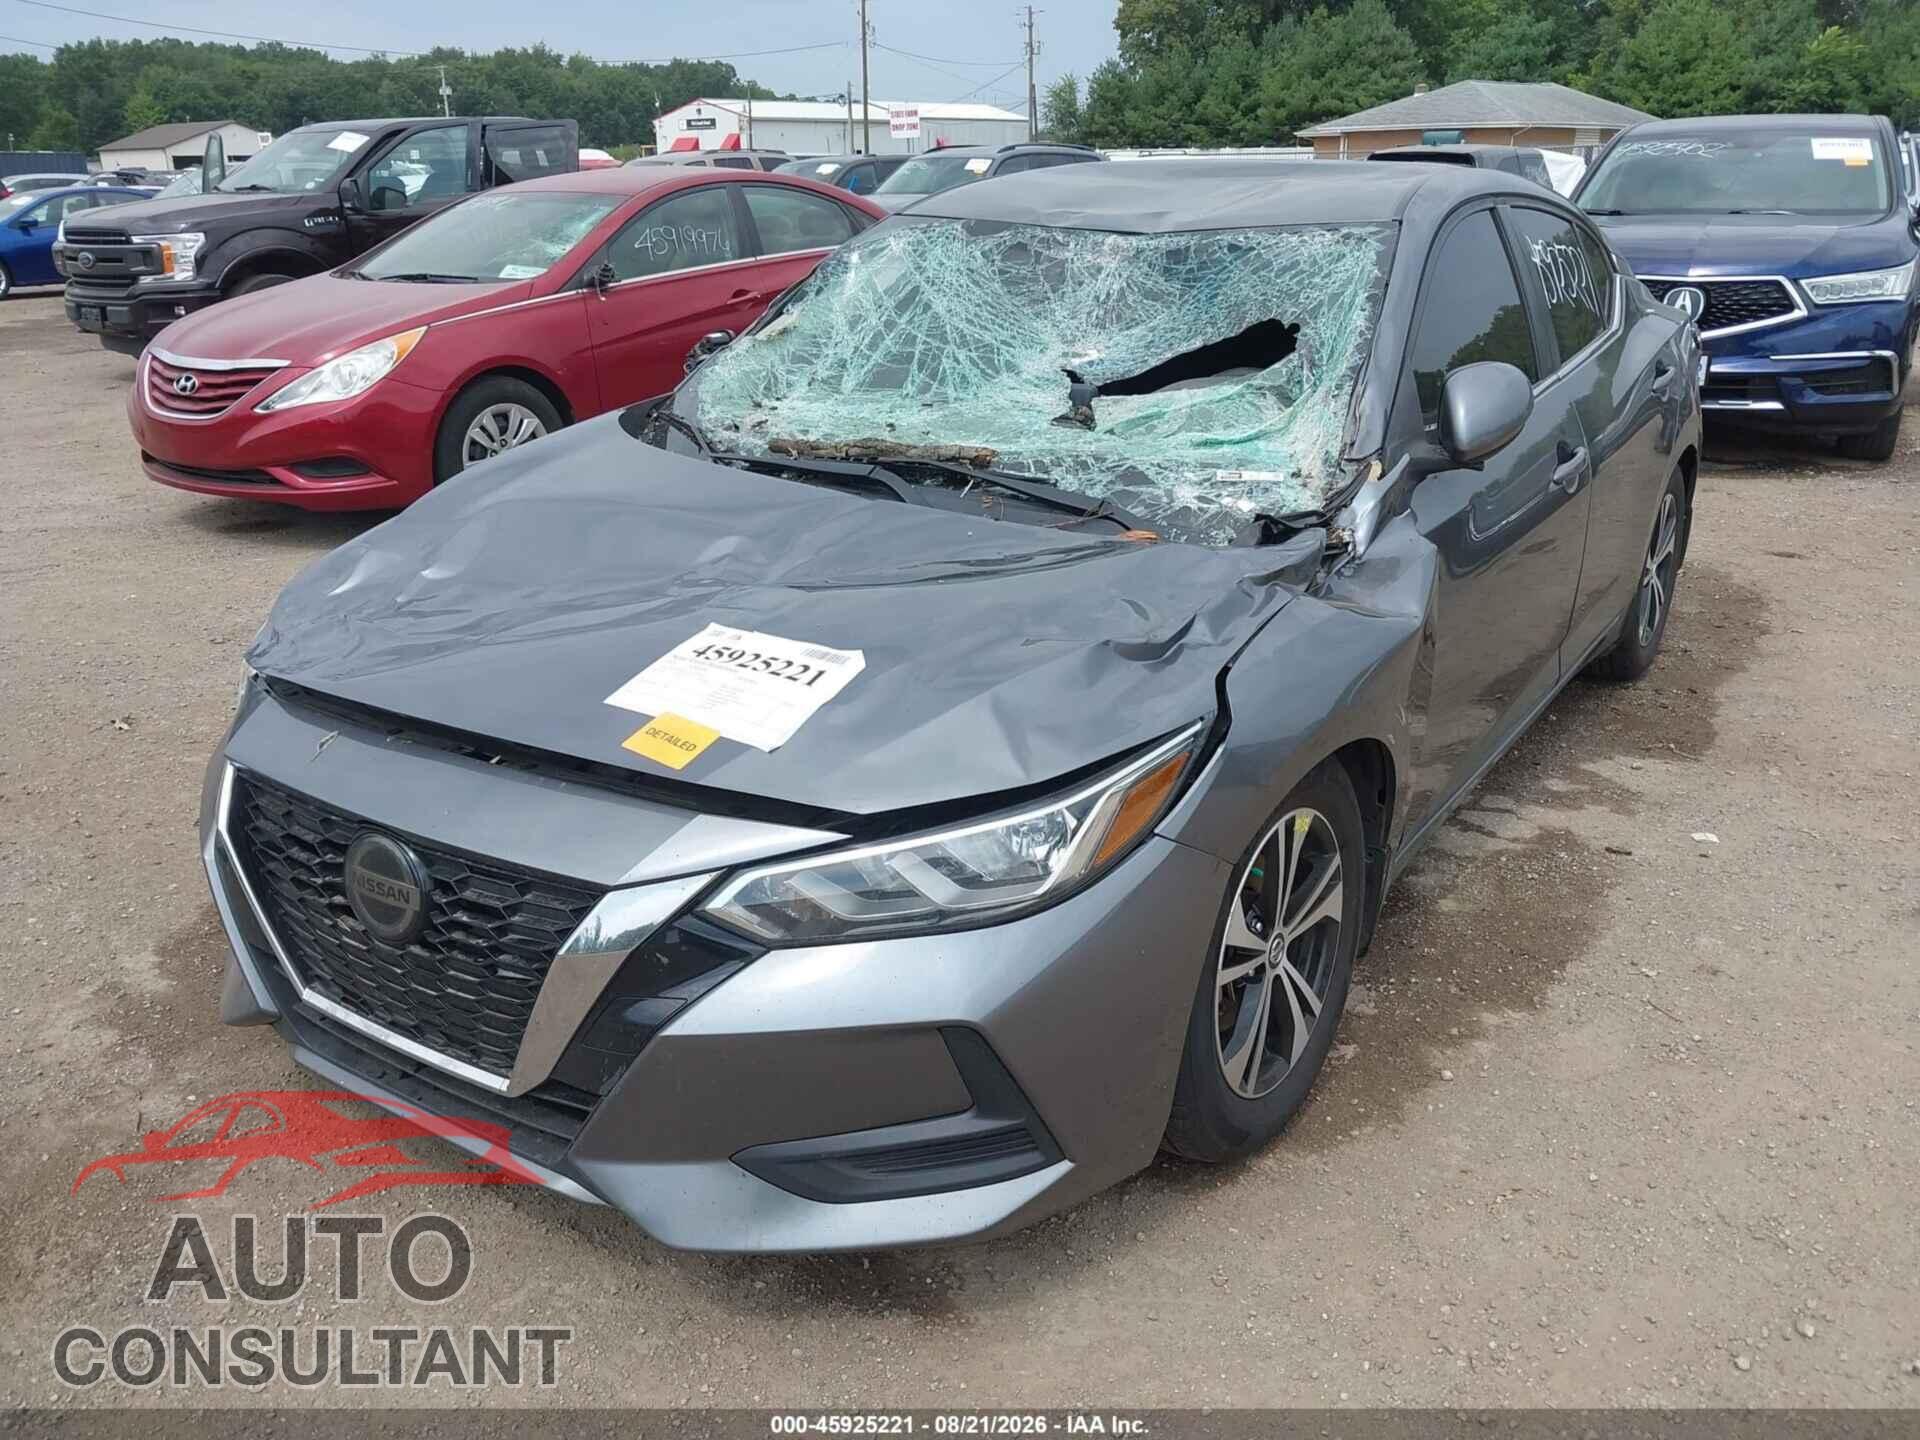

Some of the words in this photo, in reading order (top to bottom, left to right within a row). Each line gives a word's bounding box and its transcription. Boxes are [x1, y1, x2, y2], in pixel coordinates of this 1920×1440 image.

[693, 644, 827, 687] 45925221
[645, 727, 697, 752] DETAILED
[353, 871, 410, 904] NISSAN
